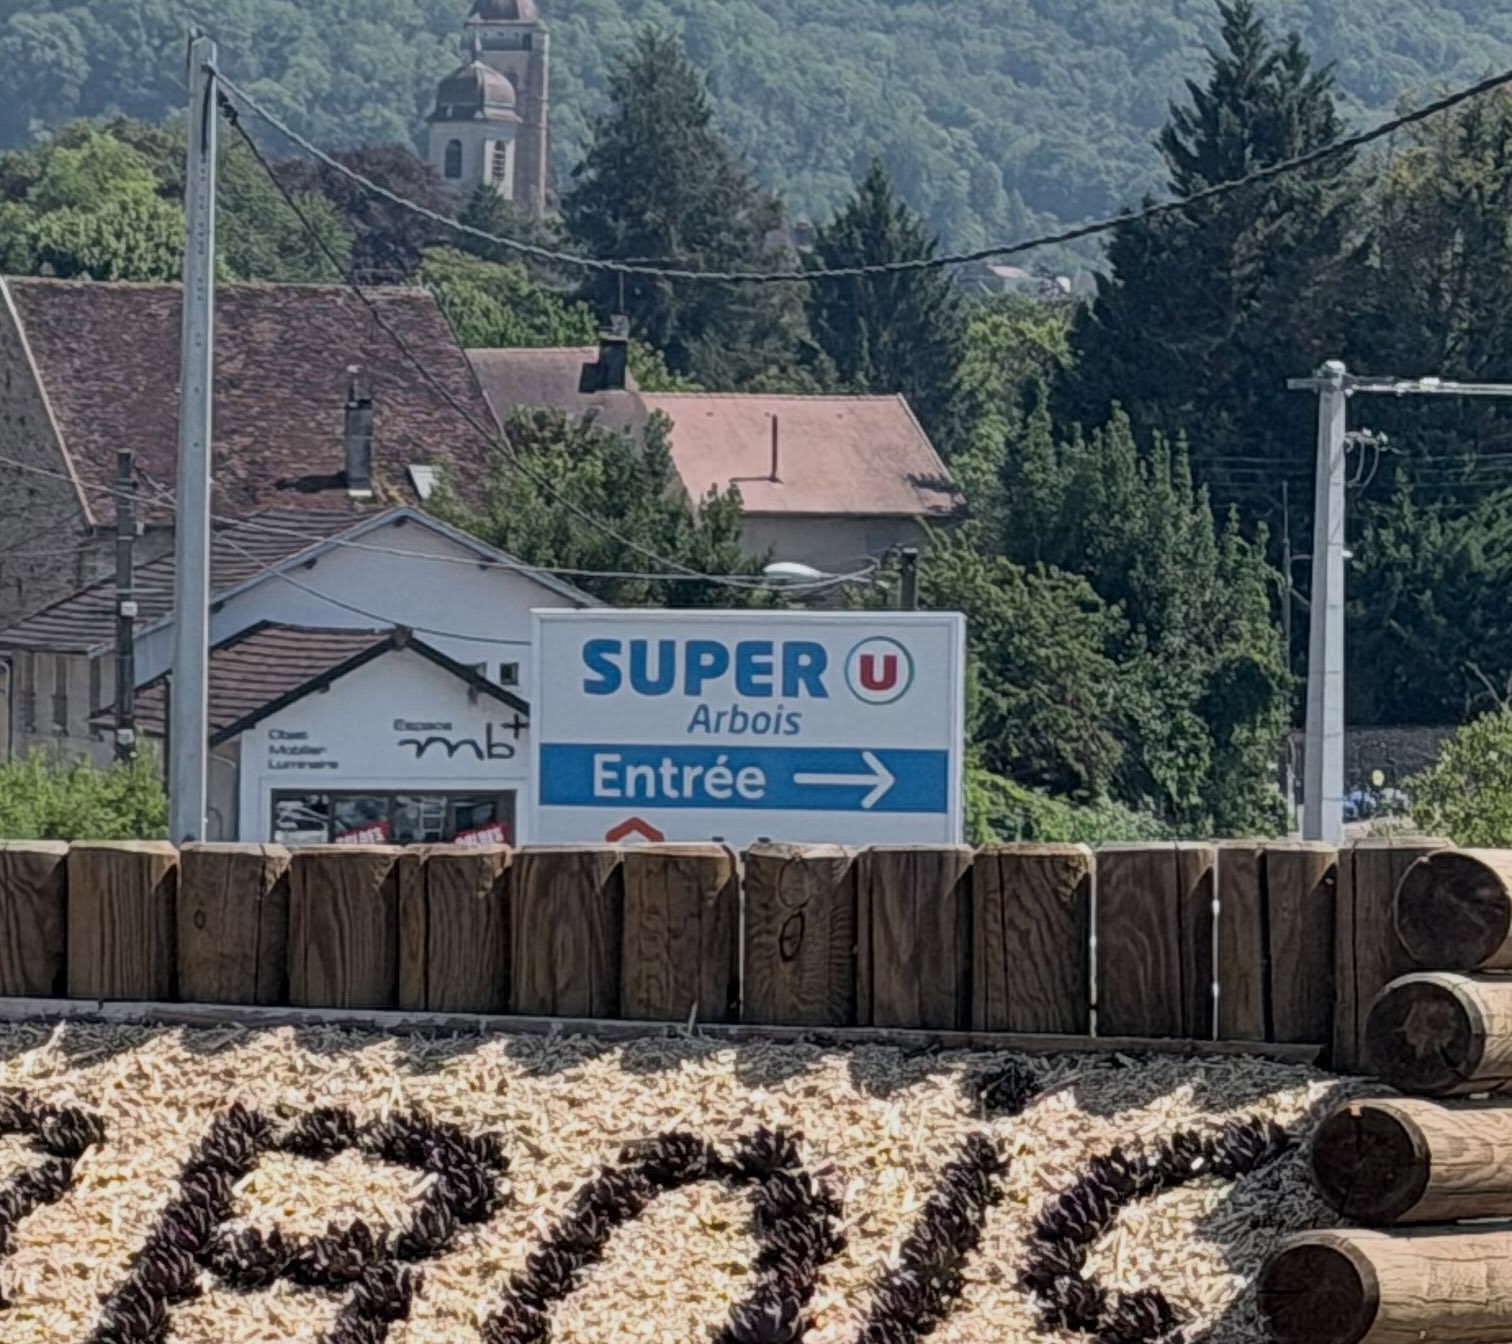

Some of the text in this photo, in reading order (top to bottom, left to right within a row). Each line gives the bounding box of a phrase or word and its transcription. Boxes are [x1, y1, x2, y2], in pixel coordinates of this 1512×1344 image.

[583, 638, 898, 698] SUPER U
[687, 703, 803, 736] Arbois
[593, 752, 767, 800] Entrée
